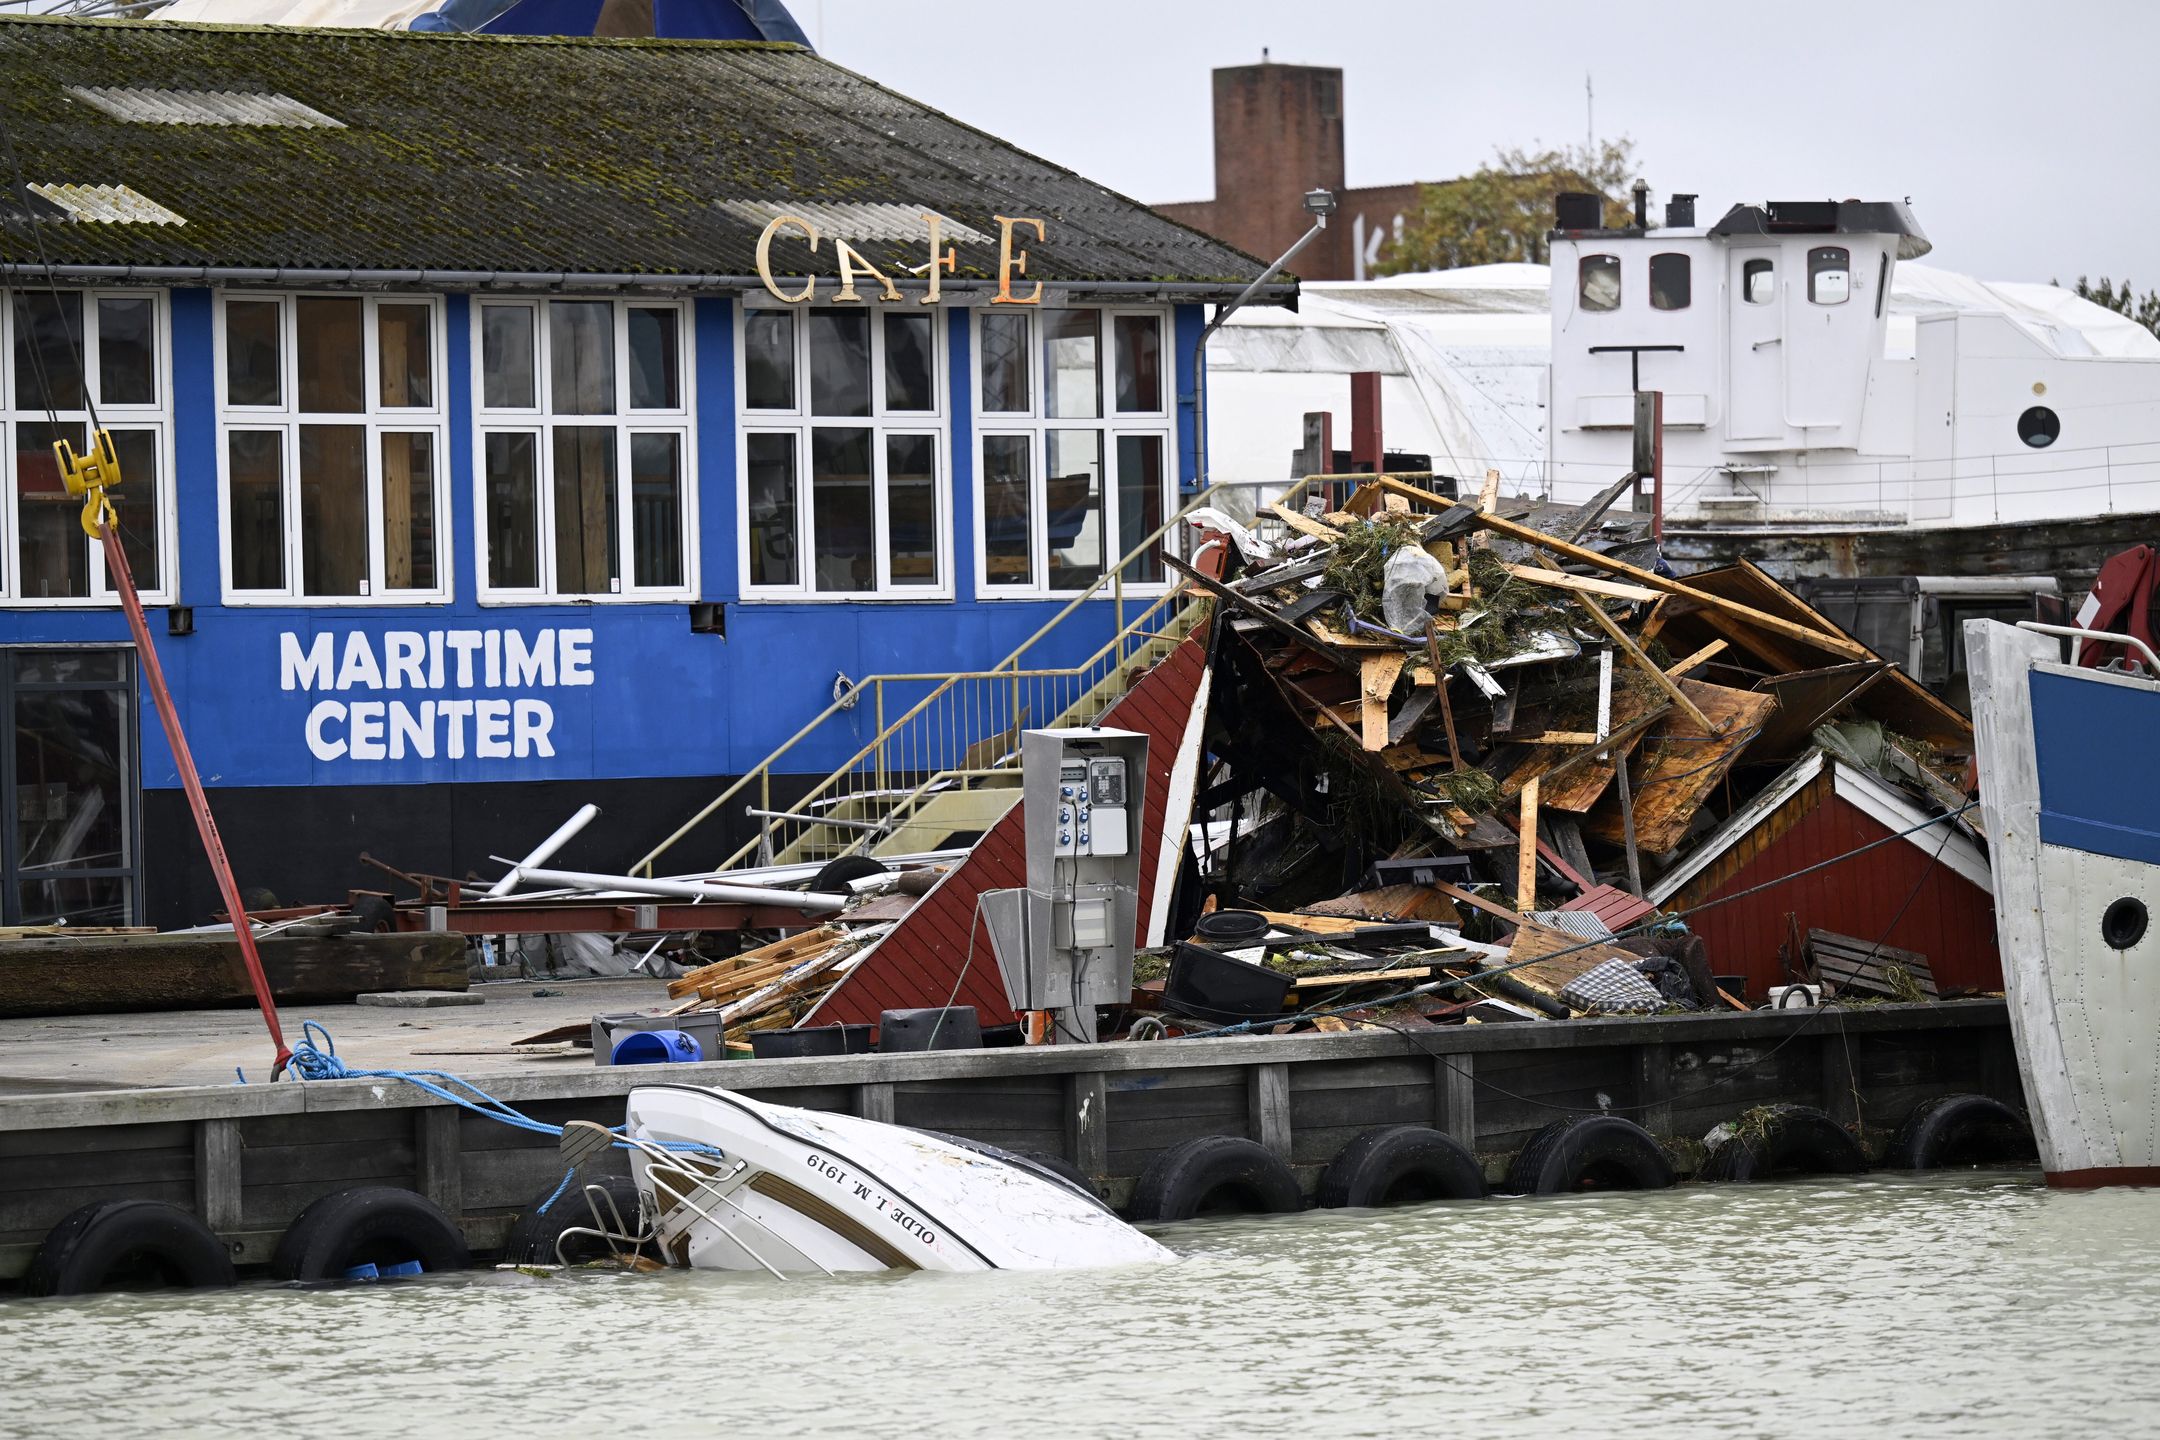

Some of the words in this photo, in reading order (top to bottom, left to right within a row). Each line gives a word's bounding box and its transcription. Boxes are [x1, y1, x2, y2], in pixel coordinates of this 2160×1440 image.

[755, 214, 1046, 304] CAFE
[280, 628, 595, 691] MARITIME
[305, 699, 556, 762] CENTER
[806, 1154, 848, 1185] 1919
[852, 1180, 873, 1201] M.
[890, 1207, 936, 1245] OLDE
